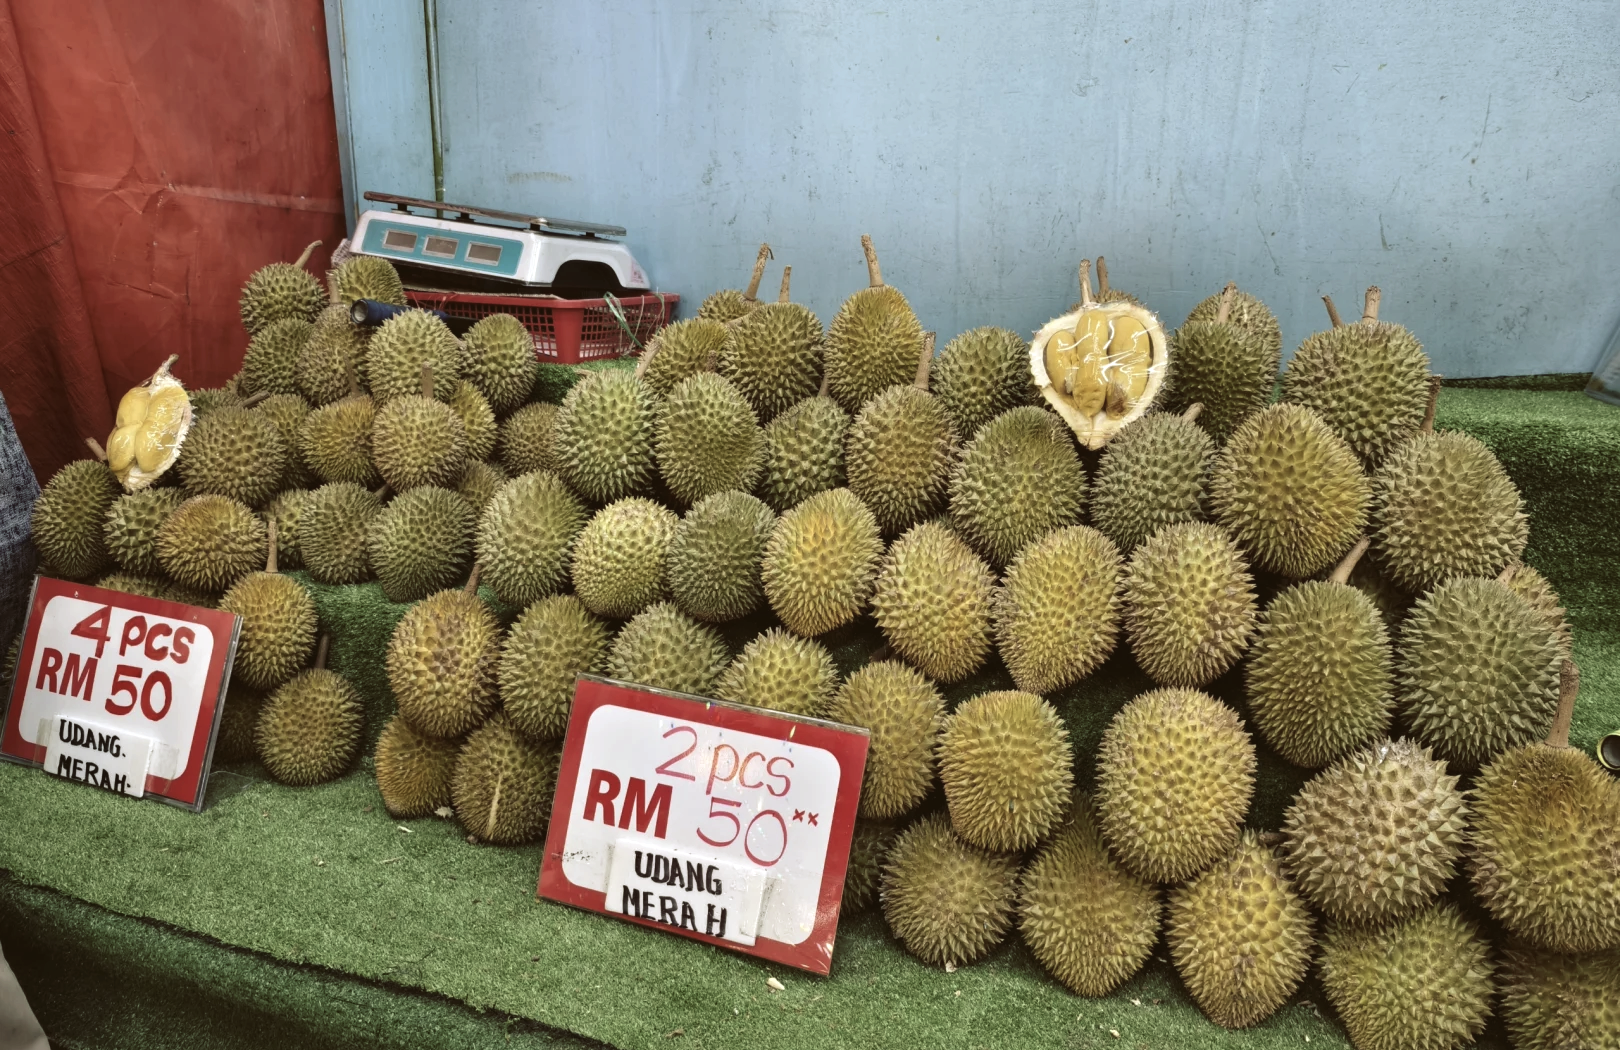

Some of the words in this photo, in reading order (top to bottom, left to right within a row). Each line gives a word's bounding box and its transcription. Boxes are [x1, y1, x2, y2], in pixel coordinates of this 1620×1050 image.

[71, 606, 112, 659] 4
[35, 647, 98, 702] RM
[104, 664, 173, 722] 50
[655, 726, 698, 782] 2
[582, 768, 673, 840] RM
[634, 851, 723, 896] UDANG
[622, 885, 728, 938] MERAH
